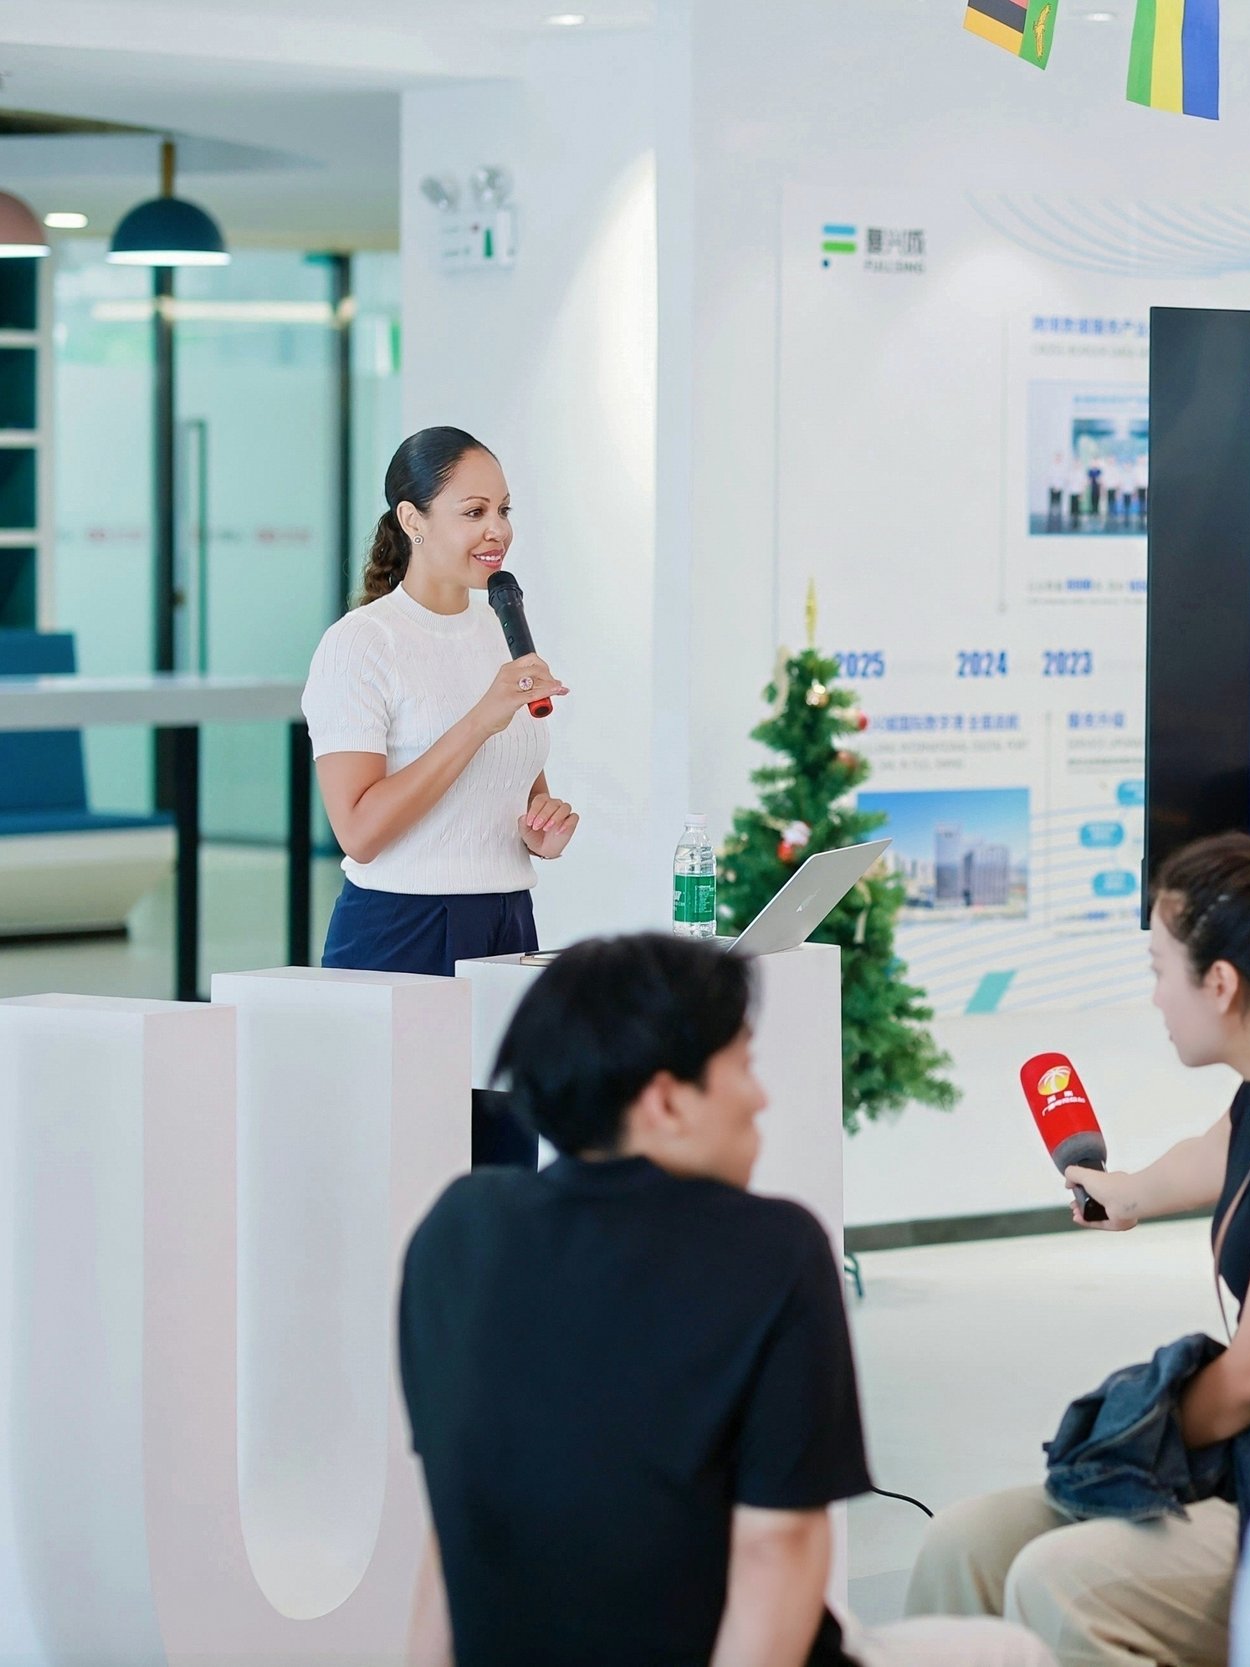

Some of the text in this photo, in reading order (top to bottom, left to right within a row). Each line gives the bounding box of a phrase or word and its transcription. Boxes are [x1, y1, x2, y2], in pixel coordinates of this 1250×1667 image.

[836, 651, 885, 678] 2025
[957, 650, 1007, 677] 2024
[1042, 650, 1093, 676] 2023
